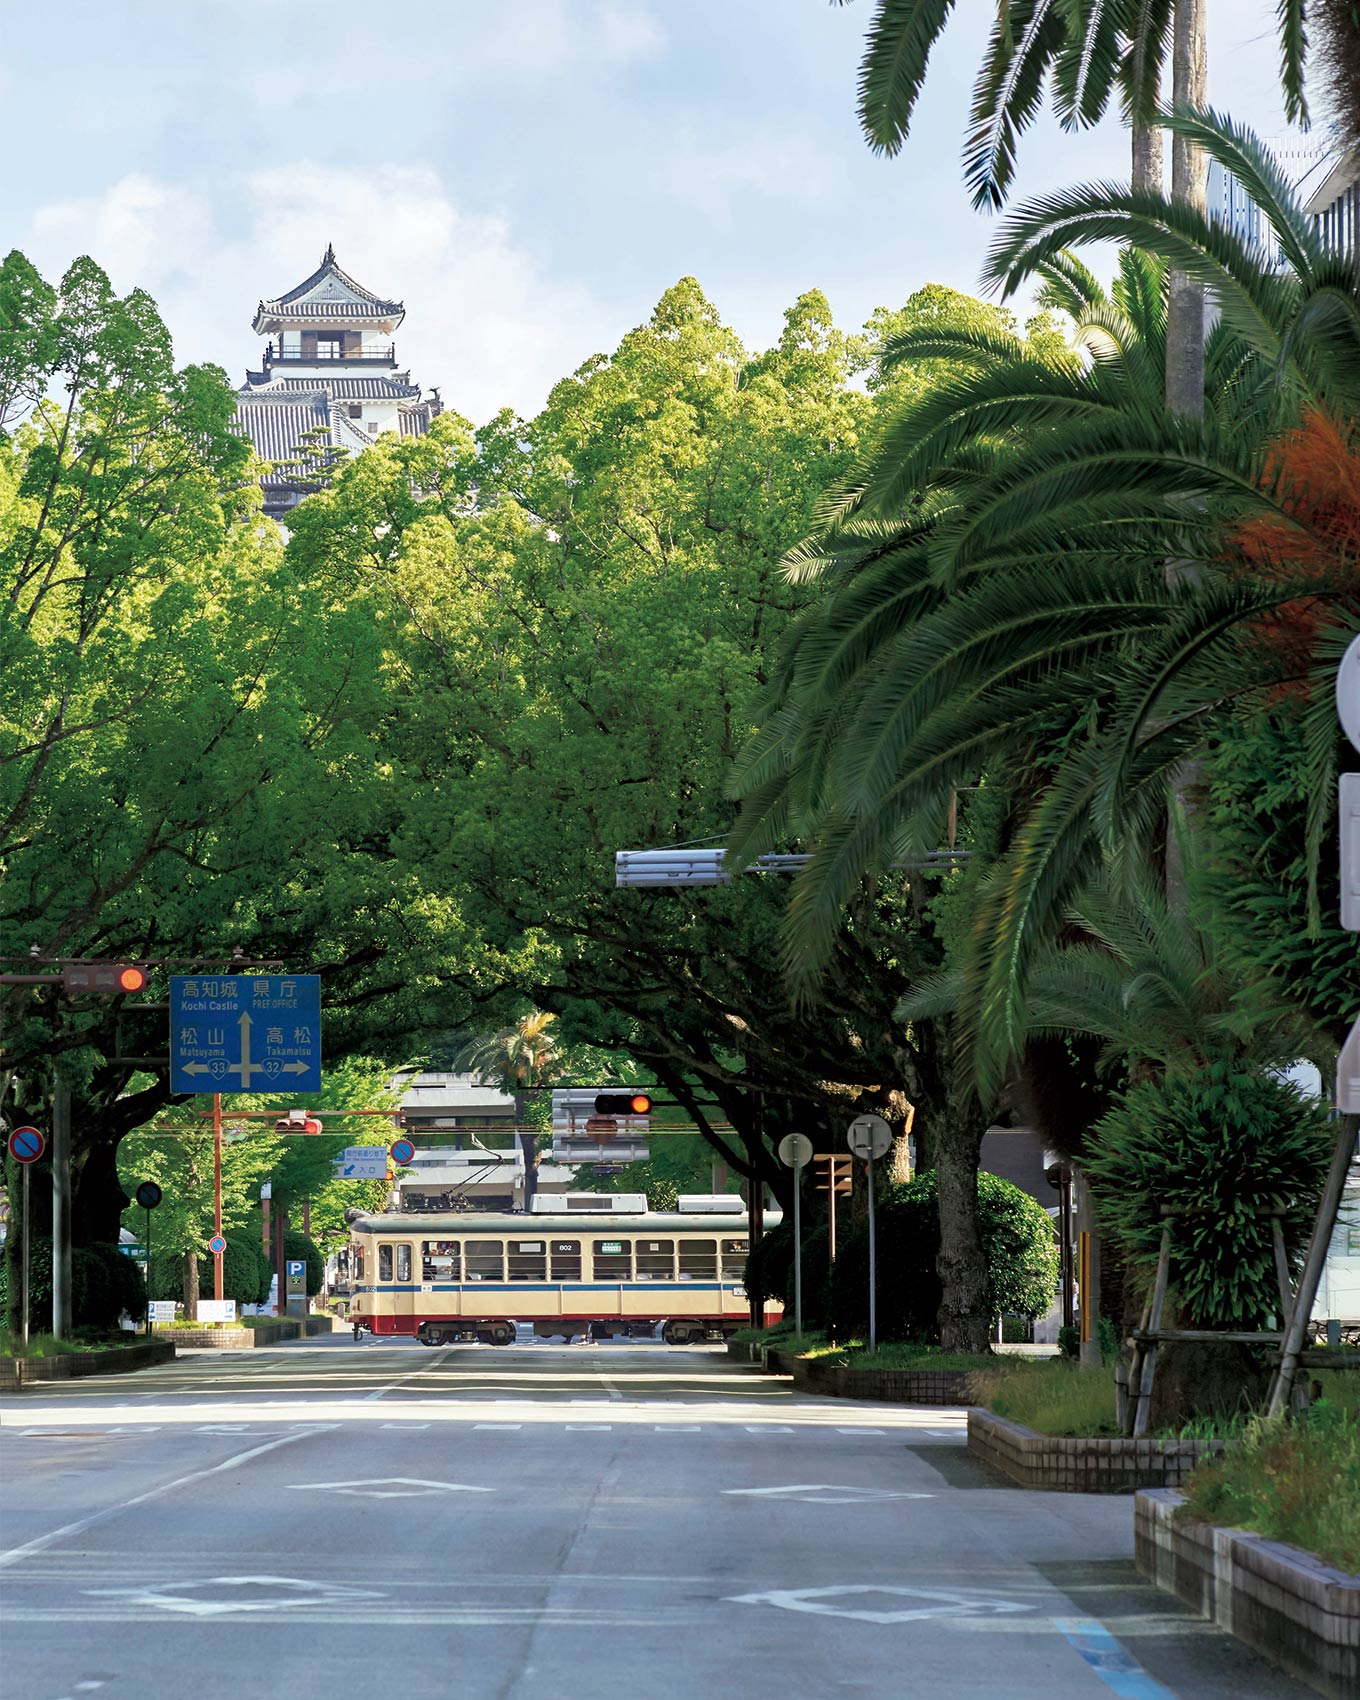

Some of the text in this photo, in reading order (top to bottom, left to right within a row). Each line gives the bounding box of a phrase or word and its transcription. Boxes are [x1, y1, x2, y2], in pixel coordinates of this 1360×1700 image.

[182, 980, 239, 998] 高知城
[254, 980, 297, 998] 県庁
[181, 1001, 238, 1011] Kochi Castle
[180, 1027, 225, 1045] 松山
[266, 1026, 312, 1044] 高松
[179, 1047, 225, 1058] Matsuyama
[266, 1046, 311, 1056] Takamatsu
[212, 1062, 225, 1073] 33
[266, 1061, 279, 1073] 32
[359, 1166, 376, 1174] 入口
[291, 1262, 302, 1275] P
